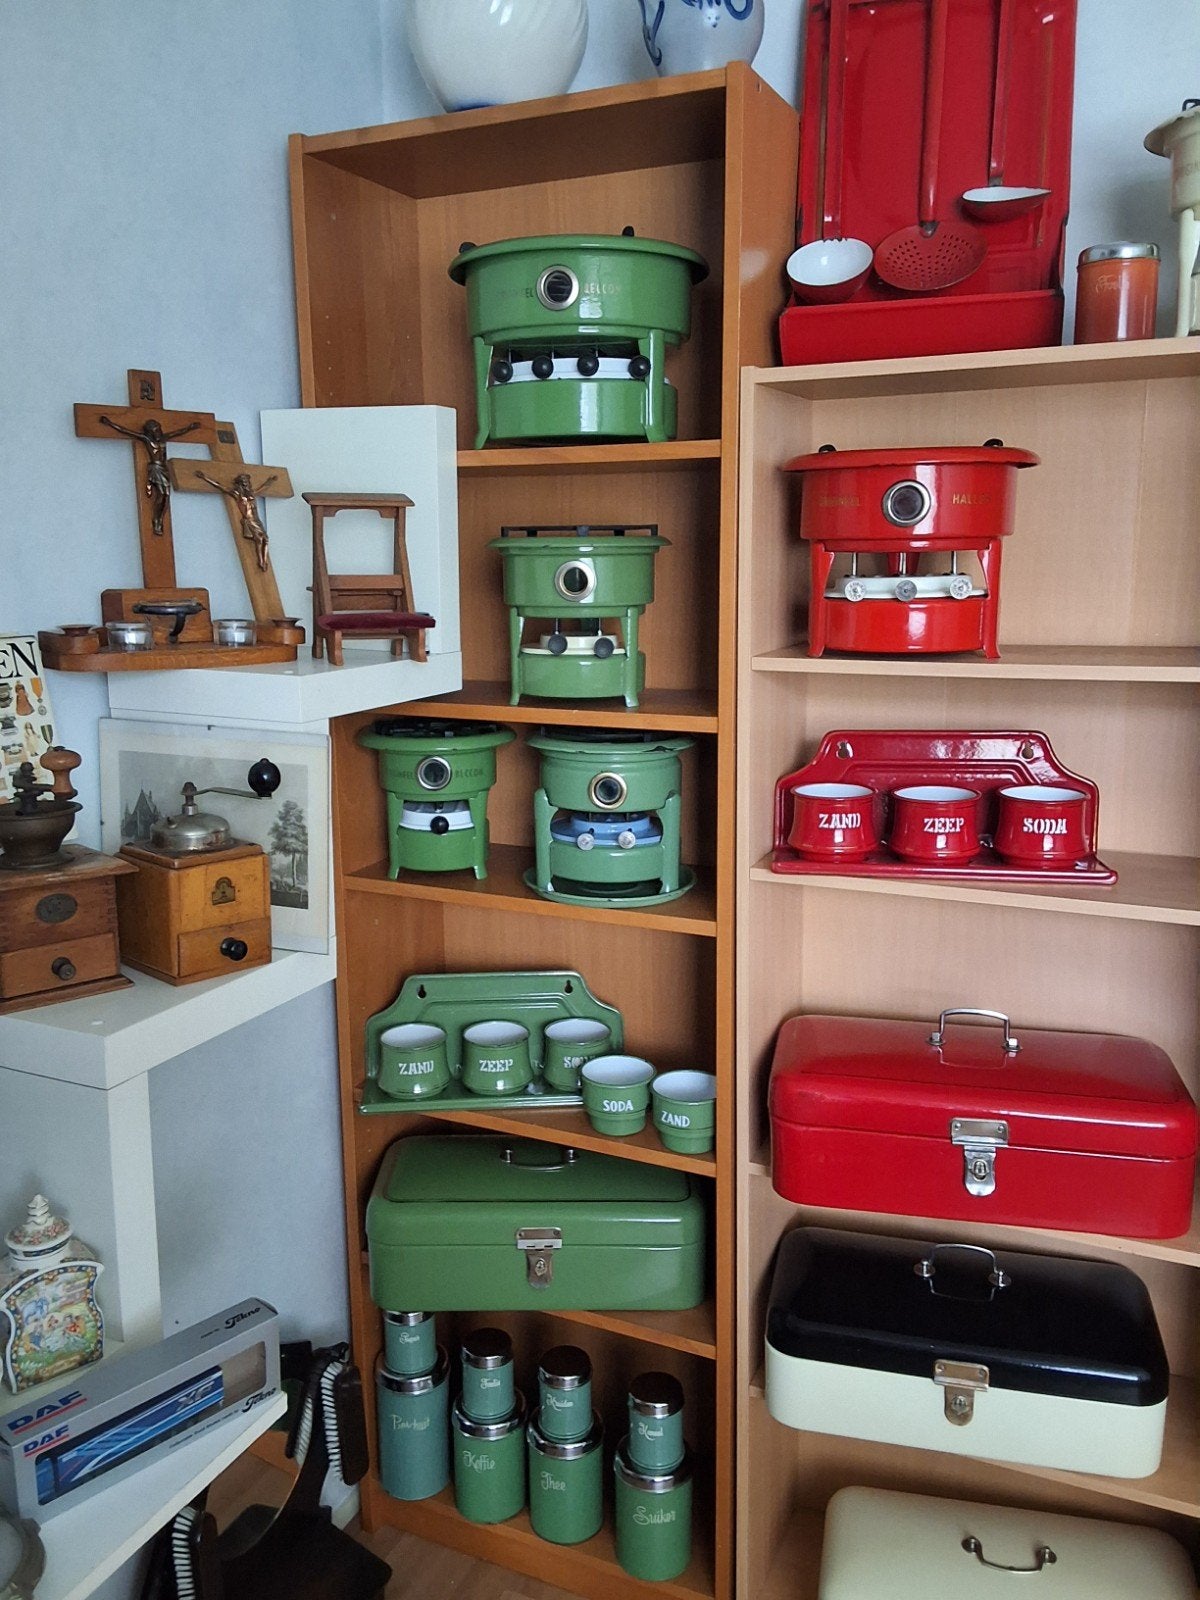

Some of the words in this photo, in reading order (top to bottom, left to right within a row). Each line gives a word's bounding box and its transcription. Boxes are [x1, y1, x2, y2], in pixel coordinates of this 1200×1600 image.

[818, 813, 861, 829] ZAND
[924, 818, 965, 833] ZEEP
[1023, 818, 1068, 835] SODA
[398, 1060, 435, 1076] ZAND
[479, 1059, 513, 1073] ZEEP
[603, 1099, 634, 1112] SODA
[661, 1110, 690, 1128] ZAND
[224, 1307, 261, 1329] Tekno
[242, 1387, 277, 1414] Tekno
[7, 1390, 83, 1431] DAF
[23, 1424, 70, 1453] DAF
[463, 1450, 496, 1473] Koffie
[541, 1471, 566, 1492] Thee
